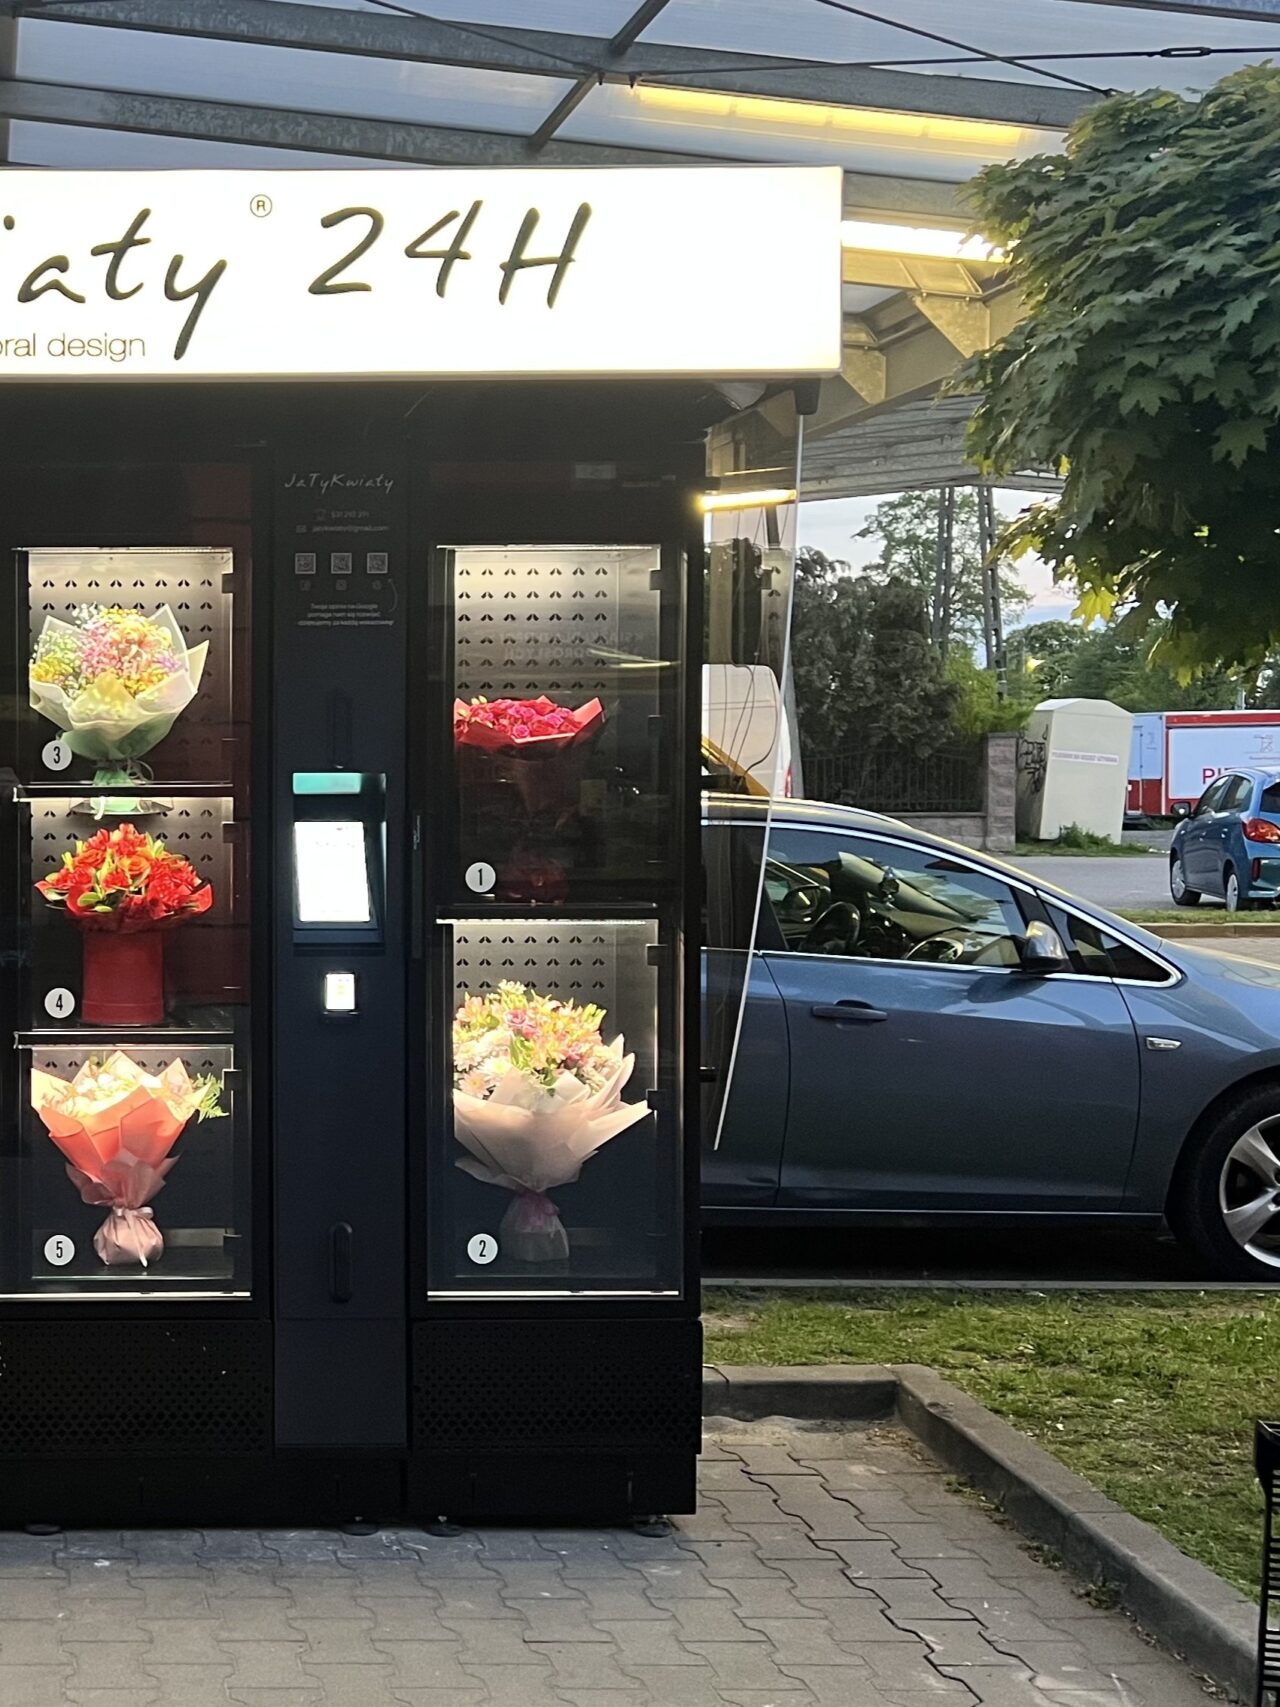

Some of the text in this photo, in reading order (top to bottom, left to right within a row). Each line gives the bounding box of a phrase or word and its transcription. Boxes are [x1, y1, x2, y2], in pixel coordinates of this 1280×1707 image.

[307, 200, 591, 309] 24H
[47, 333, 147, 363] design
[284, 472, 395, 494] JaTyKwiaty
[52, 746, 61, 764] 3
[477, 868, 484, 887] 1
[55, 994, 64, 1012] 4
[56, 1241, 64, 1259] 5
[478, 1240, 487, 1258] 2
